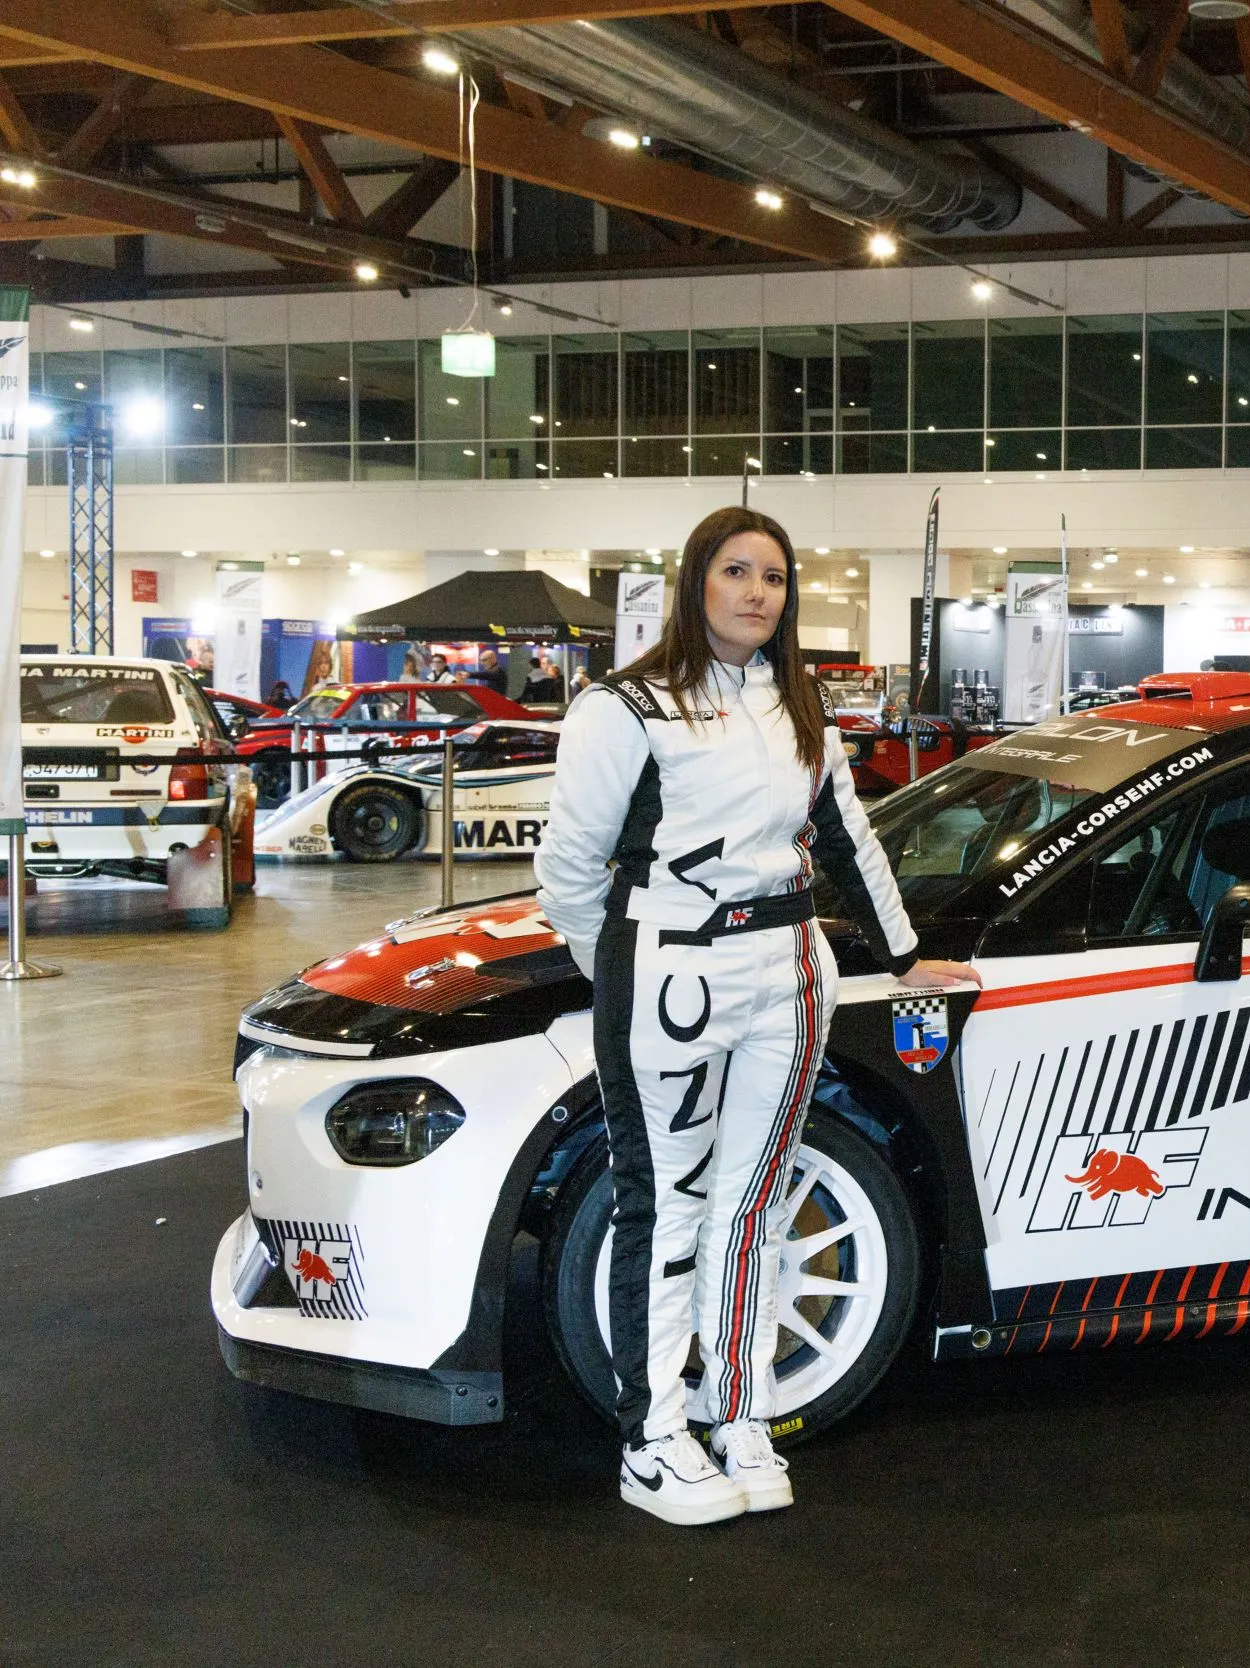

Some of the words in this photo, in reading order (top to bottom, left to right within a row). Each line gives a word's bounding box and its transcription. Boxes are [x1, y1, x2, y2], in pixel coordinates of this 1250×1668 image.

[53, 668, 154, 680] MARTINI
[618, 680, 655, 712] sparco
[99, 729, 173, 738] MARTINI
[453, 819, 549, 848] MAR
[999, 747, 1214, 898] LANCIA-CORSEHF.COM
[771, 1418, 803, 1438] PIRE
